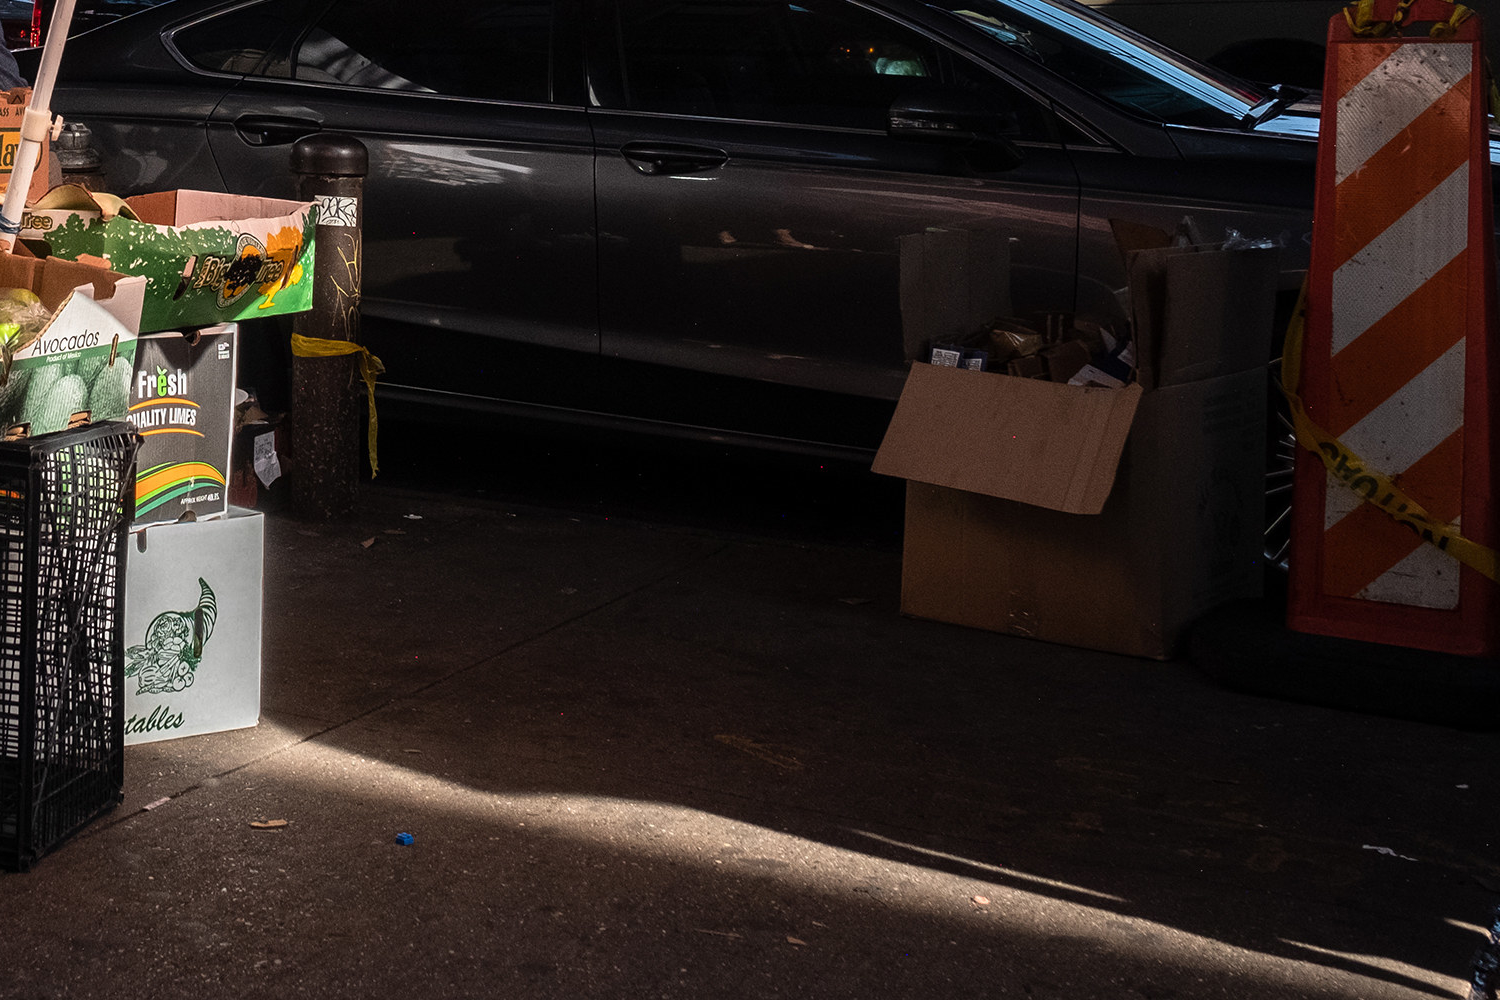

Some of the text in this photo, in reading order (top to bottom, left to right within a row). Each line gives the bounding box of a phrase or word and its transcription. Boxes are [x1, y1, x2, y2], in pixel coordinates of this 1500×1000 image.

[31, 329, 100, 357] Avocados
[126, 408, 197, 429] QUALITY LIMES
